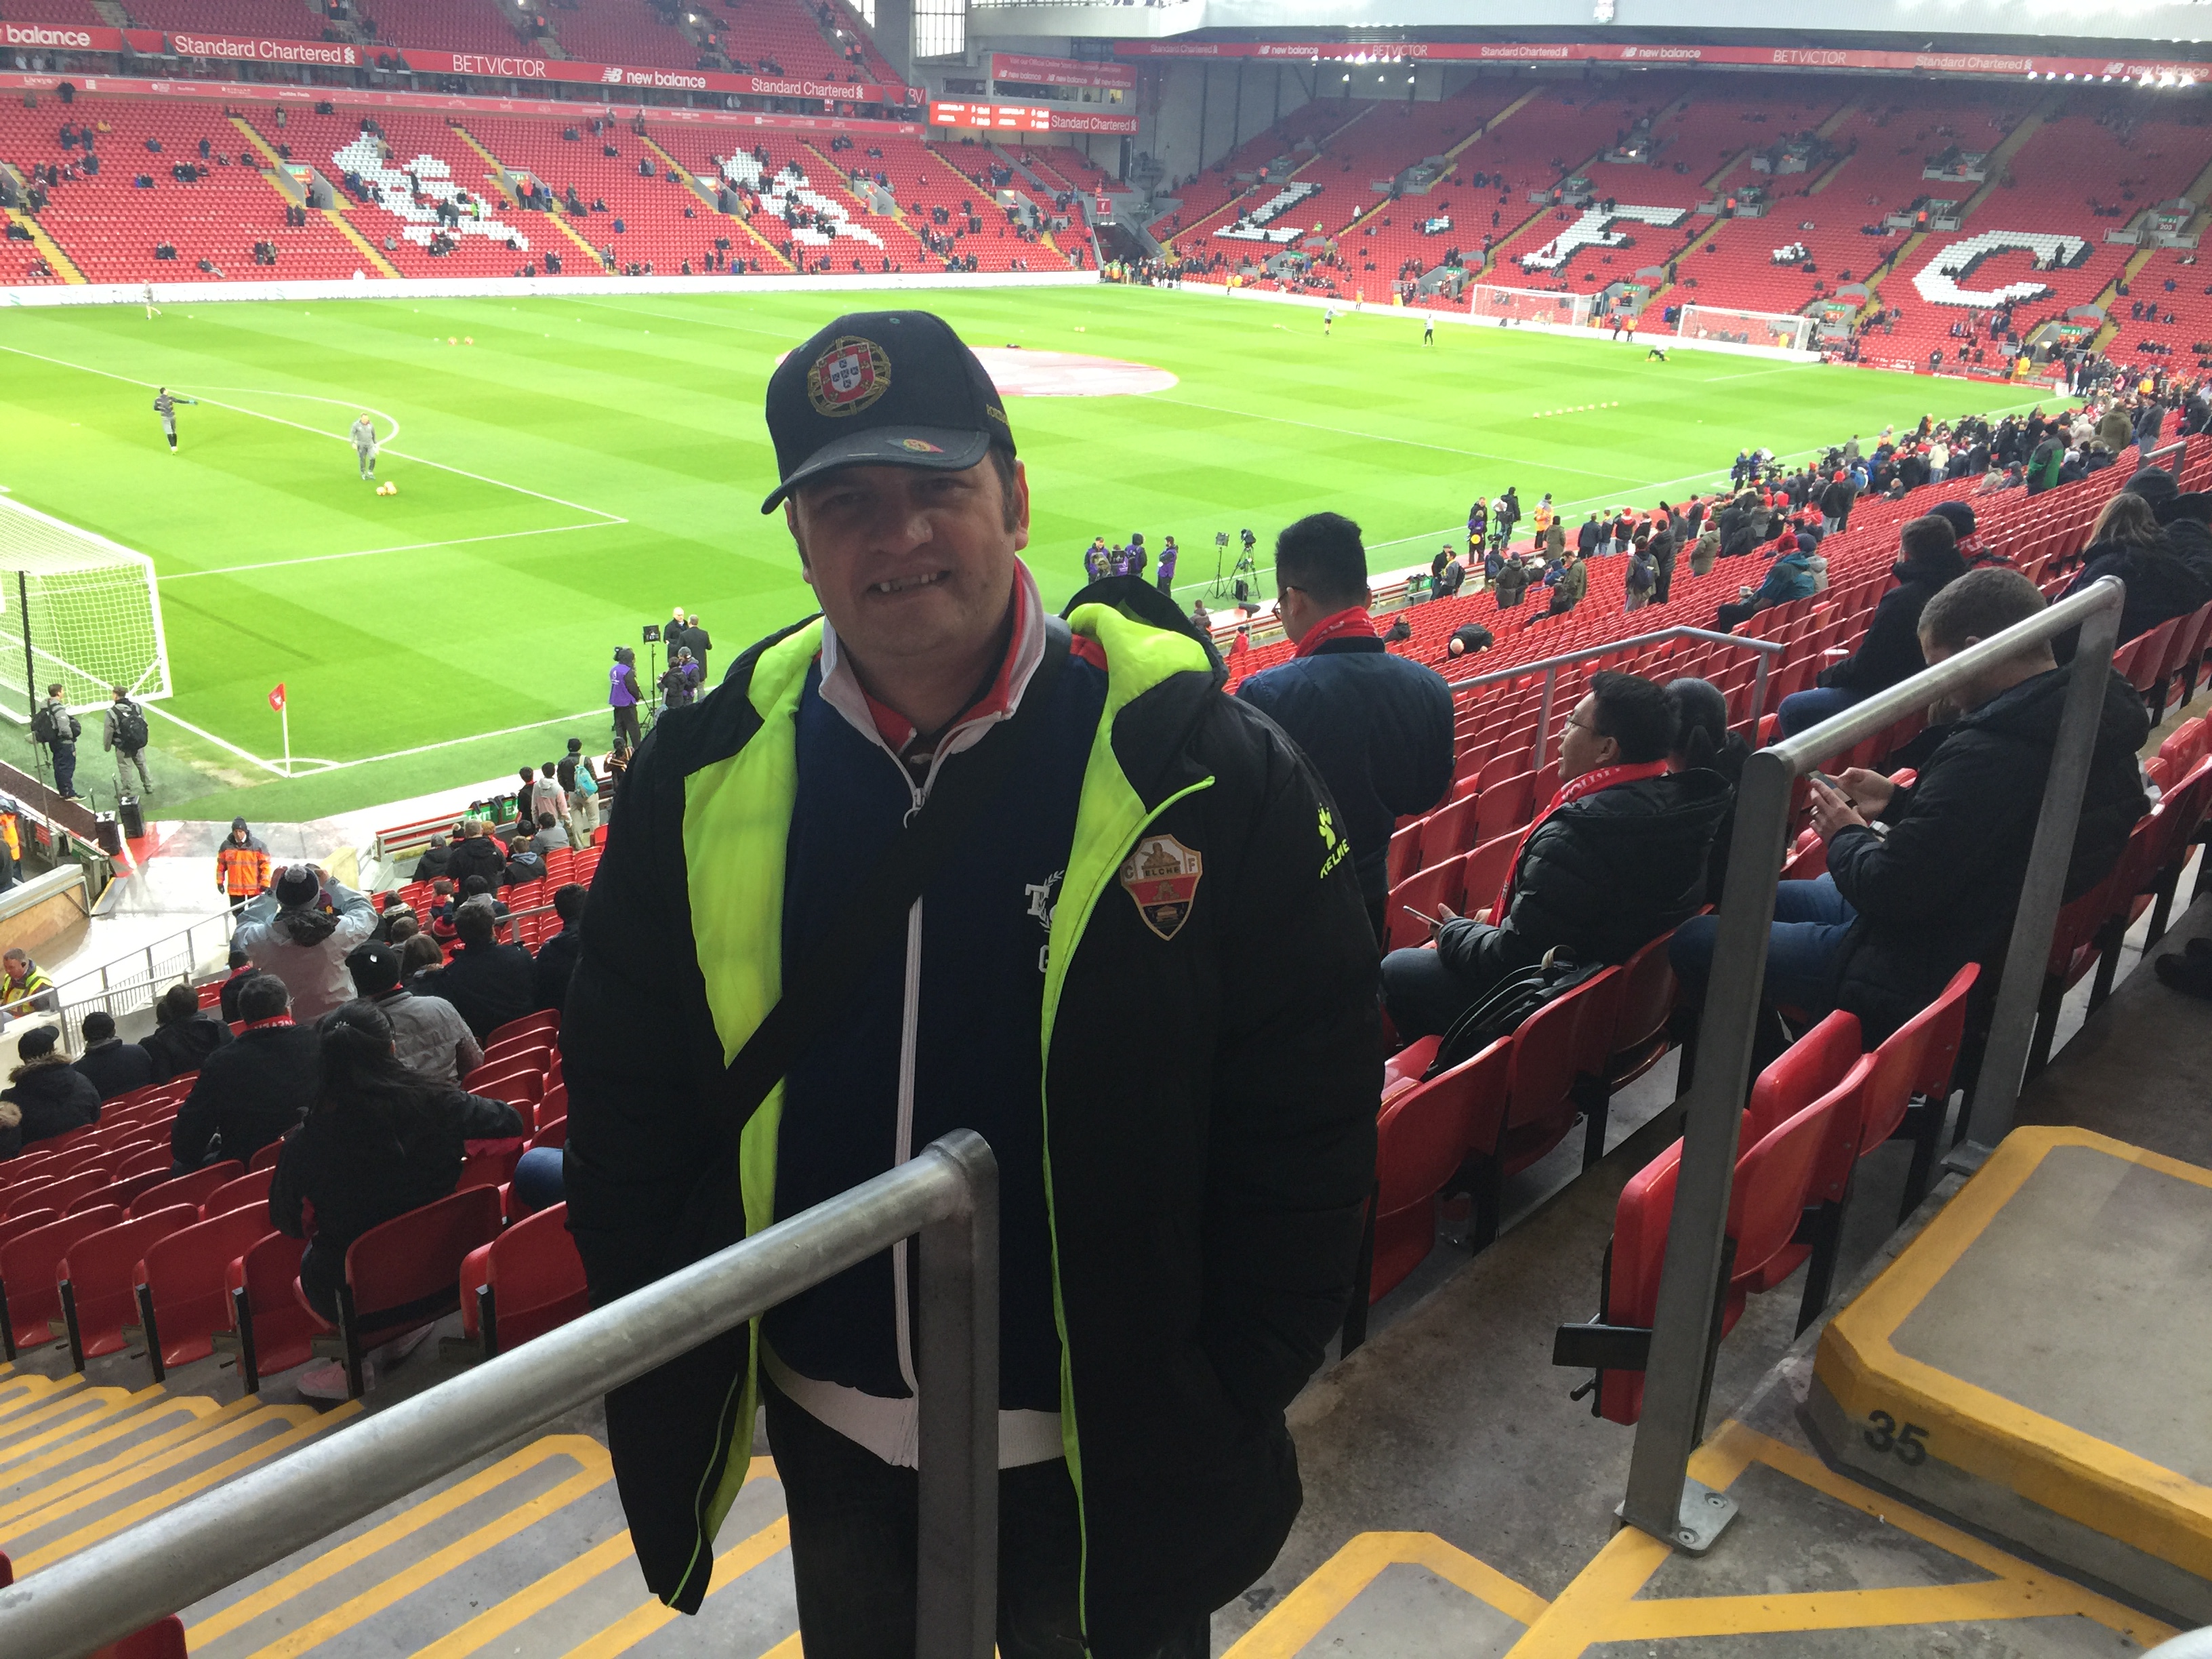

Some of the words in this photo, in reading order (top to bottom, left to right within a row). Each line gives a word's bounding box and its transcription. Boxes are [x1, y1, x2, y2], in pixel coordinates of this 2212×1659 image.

[6, 24, 90, 47] balance
[175, 35, 255, 57] Standard
[259, 41, 341, 62] Chartered
[1288, 45, 1319, 55] balance
[1481, 46, 1519, 56] Standard
[1520, 47, 1561, 57] Chartered
[1639, 49, 1660, 58] new
[1660, 48, 1701, 58] balance
[1774, 49, 1847, 64] BETVICTOR
[453, 54, 546, 77] BETVICTOR
[1916, 56, 1965, 68] Standard
[1968, 56, 2023, 69] Chartered
[626, 72, 653, 84] new
[655, 71, 706, 89] balance
[752, 78, 801, 95] Standard
[803, 81, 855, 98] Chartered
[1051, 115, 1089, 129] Standard
[1090, 119, 1130, 131] Chartered
[1145, 867, 1181, 877] ELCHE
[1864, 1409, 1930, 1467] 35
